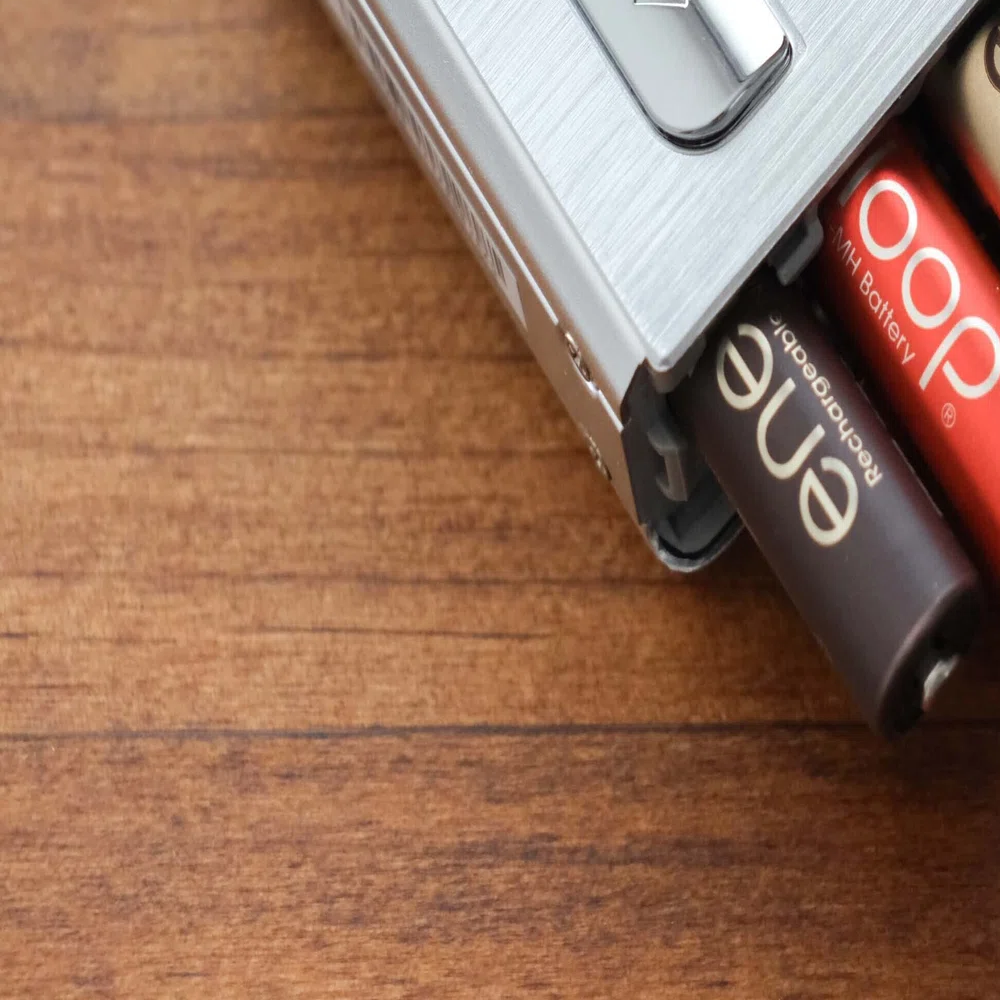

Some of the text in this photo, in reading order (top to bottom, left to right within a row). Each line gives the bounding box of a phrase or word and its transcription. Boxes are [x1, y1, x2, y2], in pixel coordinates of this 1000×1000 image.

[769, 313, 883, 487] Rechargeable
[859, 270, 915, 365] Battery
[716, 323, 859, 547] ene
